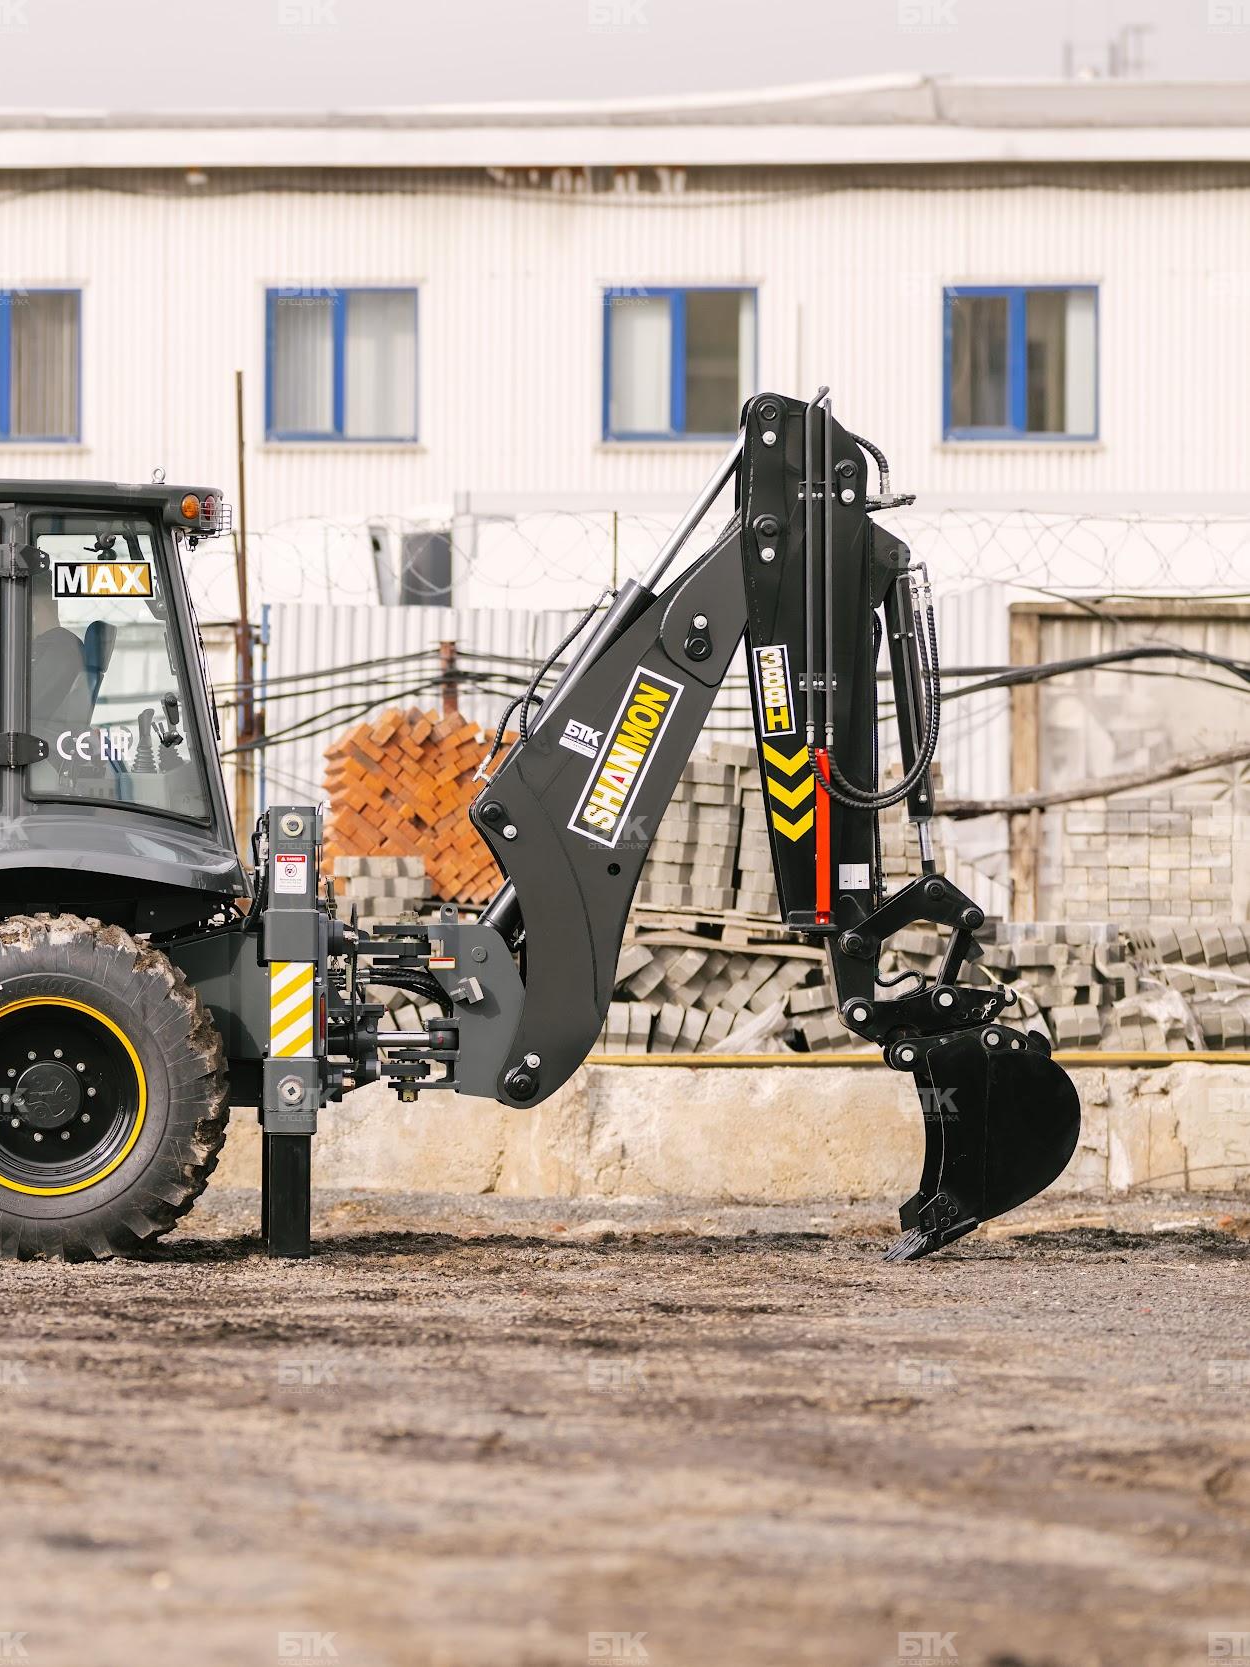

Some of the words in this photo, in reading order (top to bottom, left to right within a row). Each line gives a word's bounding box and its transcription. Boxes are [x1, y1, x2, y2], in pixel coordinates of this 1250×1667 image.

[57, 565, 148, 594] MAX
[760, 649, 791, 731] 388H
[56, 730, 91, 760] CE
[564, 718, 604, 748] БТК
[581, 682, 671, 832] SHANMON
